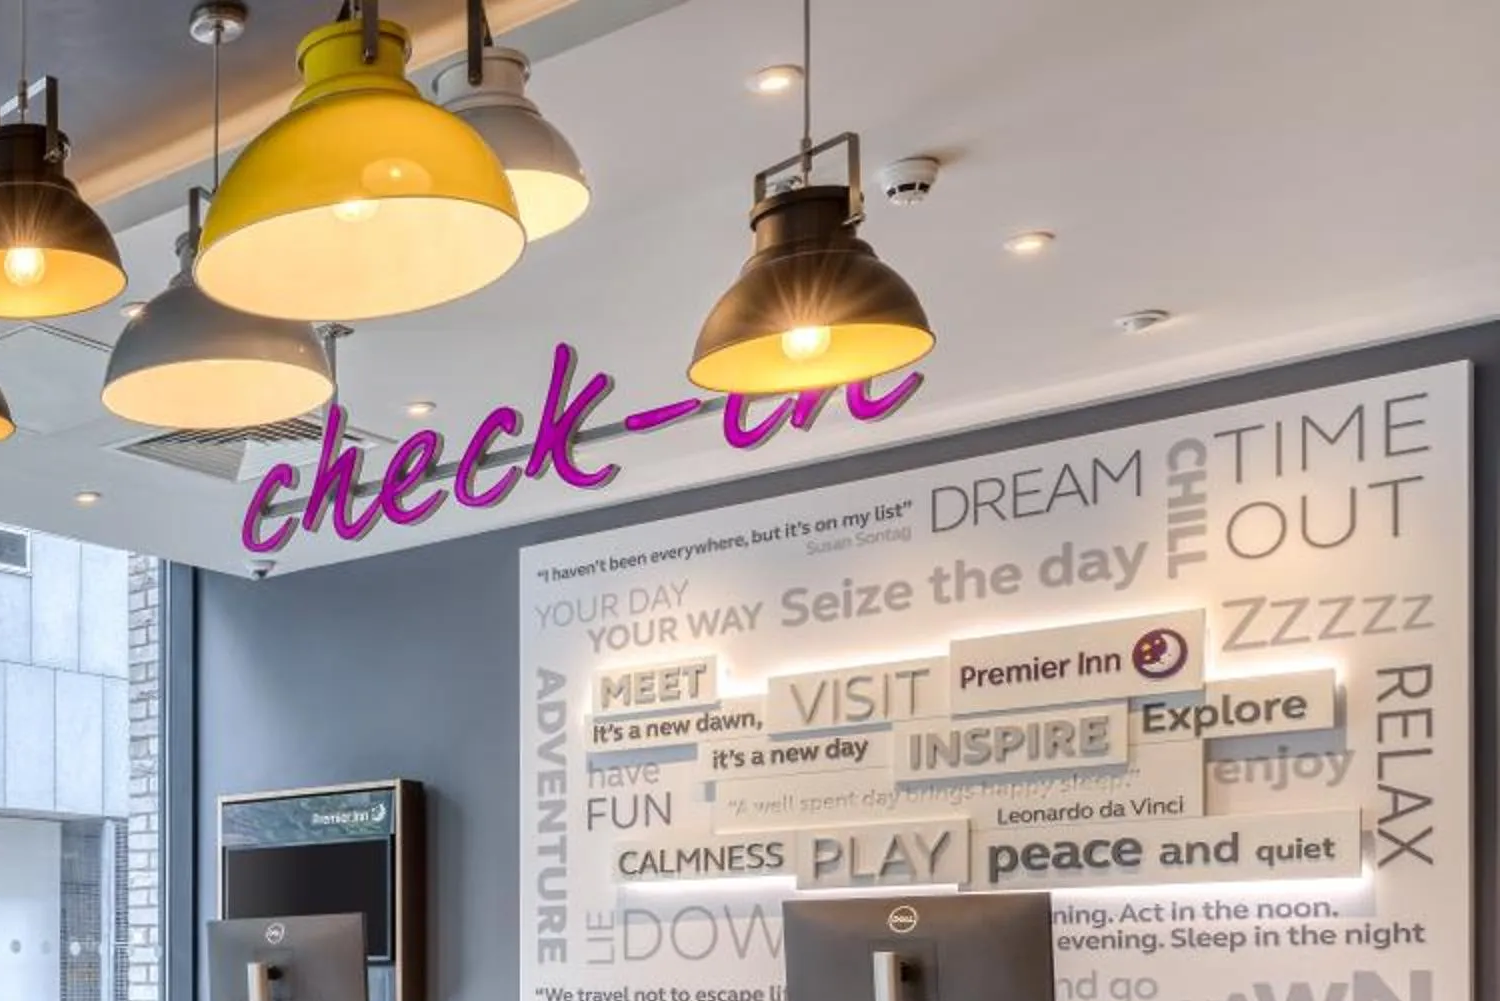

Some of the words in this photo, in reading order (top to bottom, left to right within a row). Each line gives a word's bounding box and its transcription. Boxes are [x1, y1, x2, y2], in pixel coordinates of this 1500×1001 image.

[1214, 393, 1430, 483] TIME
[931, 449, 1141, 533] DREAM
[1167, 437, 1207, 578] CHILL
[609, 552, 647, 571] been
[651, 532, 749, 564] everywhere,
[752, 526, 780, 544] but
[815, 517, 837, 532] on
[842, 509, 870, 530] my
[806, 535, 853, 555] Susan
[856, 524, 912, 546] Sontag
[1227, 476, 1424, 559] OUT
[534, 593, 617, 628] YOUR
[629, 580, 689, 614] DAY
[782, 578, 913, 626] Seize
[928, 558, 1021, 600] the
[1039, 541, 1148, 590] day
[587, 616, 678, 654] YOUR
[687, 602, 762, 637] WAY
[602, 664, 706, 708] MEET
[961, 654, 1068, 689] Premier
[1078, 652, 1121, 676] Inn
[790, 669, 930, 724] VISIT
[1142, 693, 1308, 738] Explore
[628, 725, 641, 739] a
[645, 720, 689, 737] new
[696, 712, 762, 733] dawn,
[910, 714, 1112, 771] INSPIRE
[588, 759, 660, 789] have
[752, 754, 765, 766] a
[770, 744, 820, 764] new
[825, 737, 869, 762] day
[1213, 745, 1355, 791] enjoy
[1377, 664, 1433, 866] RELAX
[536, 668, 566, 964] ADVENTURE
[587, 793, 672, 831] FUN
[753, 796, 794, 815] well
[800, 793, 854, 814] spent
[862, 789, 898, 809] day
[997, 806, 1094, 825] Leonardo
[1100, 800, 1125, 818] da
[1130, 796, 1184, 814] Vinci
[618, 841, 783, 875] CALMNESS
[812, 832, 950, 880] PLAY
[989, 836, 1142, 882] peace
[1160, 832, 1239, 867] and
[1256, 838, 1335, 866] quiet
[586, 910, 614, 964] LIE
[623, 904, 782, 962] DOW
[1053, 906, 1114, 927] ning.
[1120, 903, 1163, 922] Act
[1171, 901, 1195, 921] in
[1201, 899, 1249, 920] the
[1256, 901, 1339, 919] noon.
[1057, 929, 1165, 953] evening.
[1171, 927, 1247, 953] Sleep
[1254, 927, 1280, 946] in
[1286, 925, 1337, 946] the
[1344, 922, 1425, 949] night
[1055, 970, 1098, 999] nd
